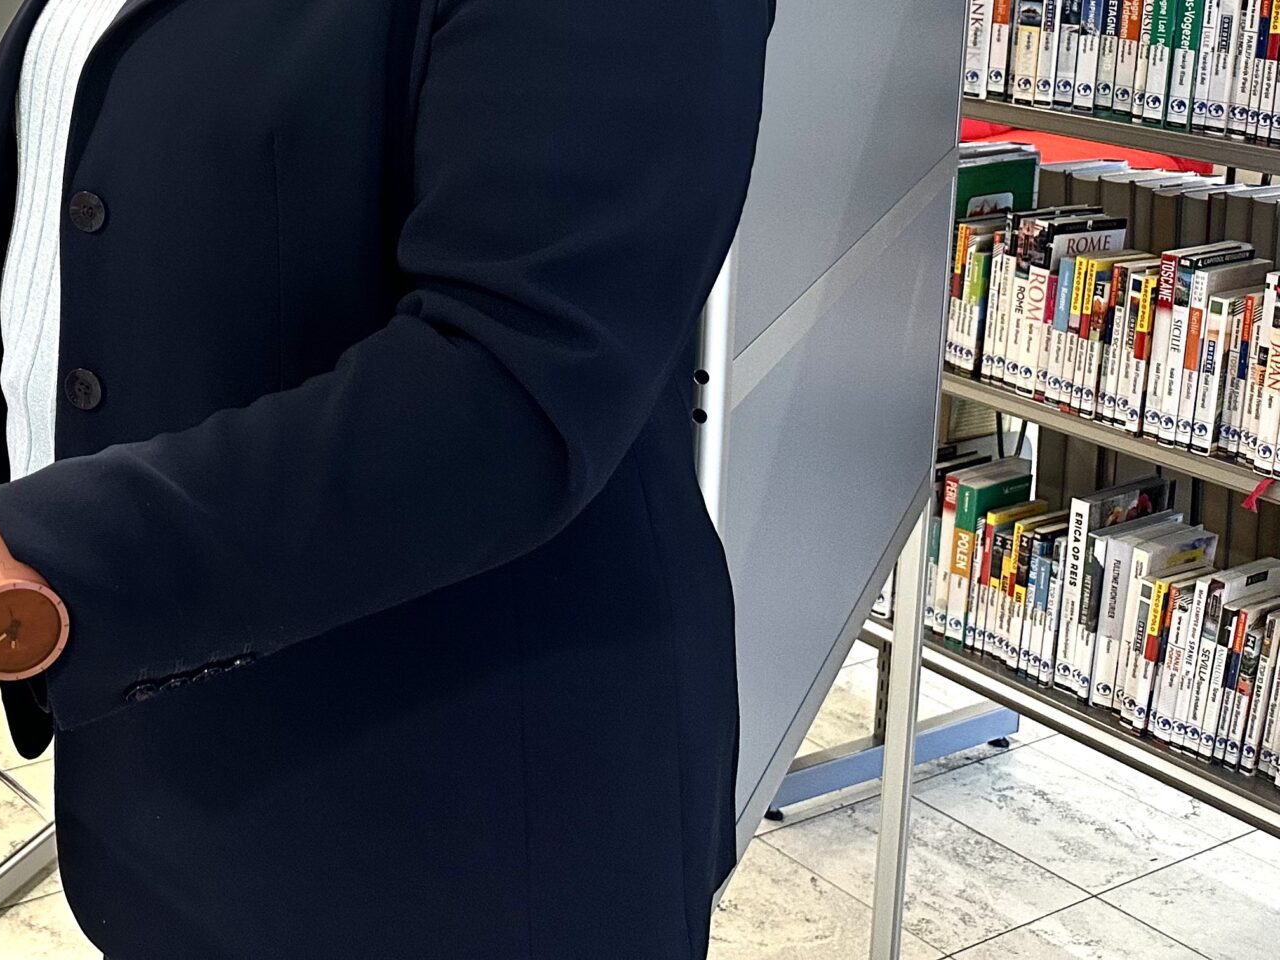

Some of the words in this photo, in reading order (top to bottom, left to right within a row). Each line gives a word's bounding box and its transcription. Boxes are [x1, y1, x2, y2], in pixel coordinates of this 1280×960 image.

[1120, 2, 1131, 38] Ardennen
[1158, 19, 1167, 33] Lot
[1066, 235, 1112, 255] ROME
[1158, 260, 1176, 303] TOSCANE
[1015, 285, 1025, 315] ROME
[1026, 272, 1047, 322] ROM
[1072, 292, 1080, 311] POLO
[1083, 293, 1091, 311] POLO
[1268, 340, 1280, 390] JAPAN
[945, 480, 958, 505] PERU
[1074, 512, 1083, 542] ERICA
[956, 532, 969, 570] POLEN
[1071, 546, 1080, 561] OP
[1069, 564, 1079, 587] REIS
[1112, 558, 1121, 585] FULLTIME
[1153, 583, 1162, 608] MARCO
[1150, 615, 1158, 632] POLO
[1188, 640, 1196, 667] SPANJE
[1199, 648, 1210, 682] SEVILLA
